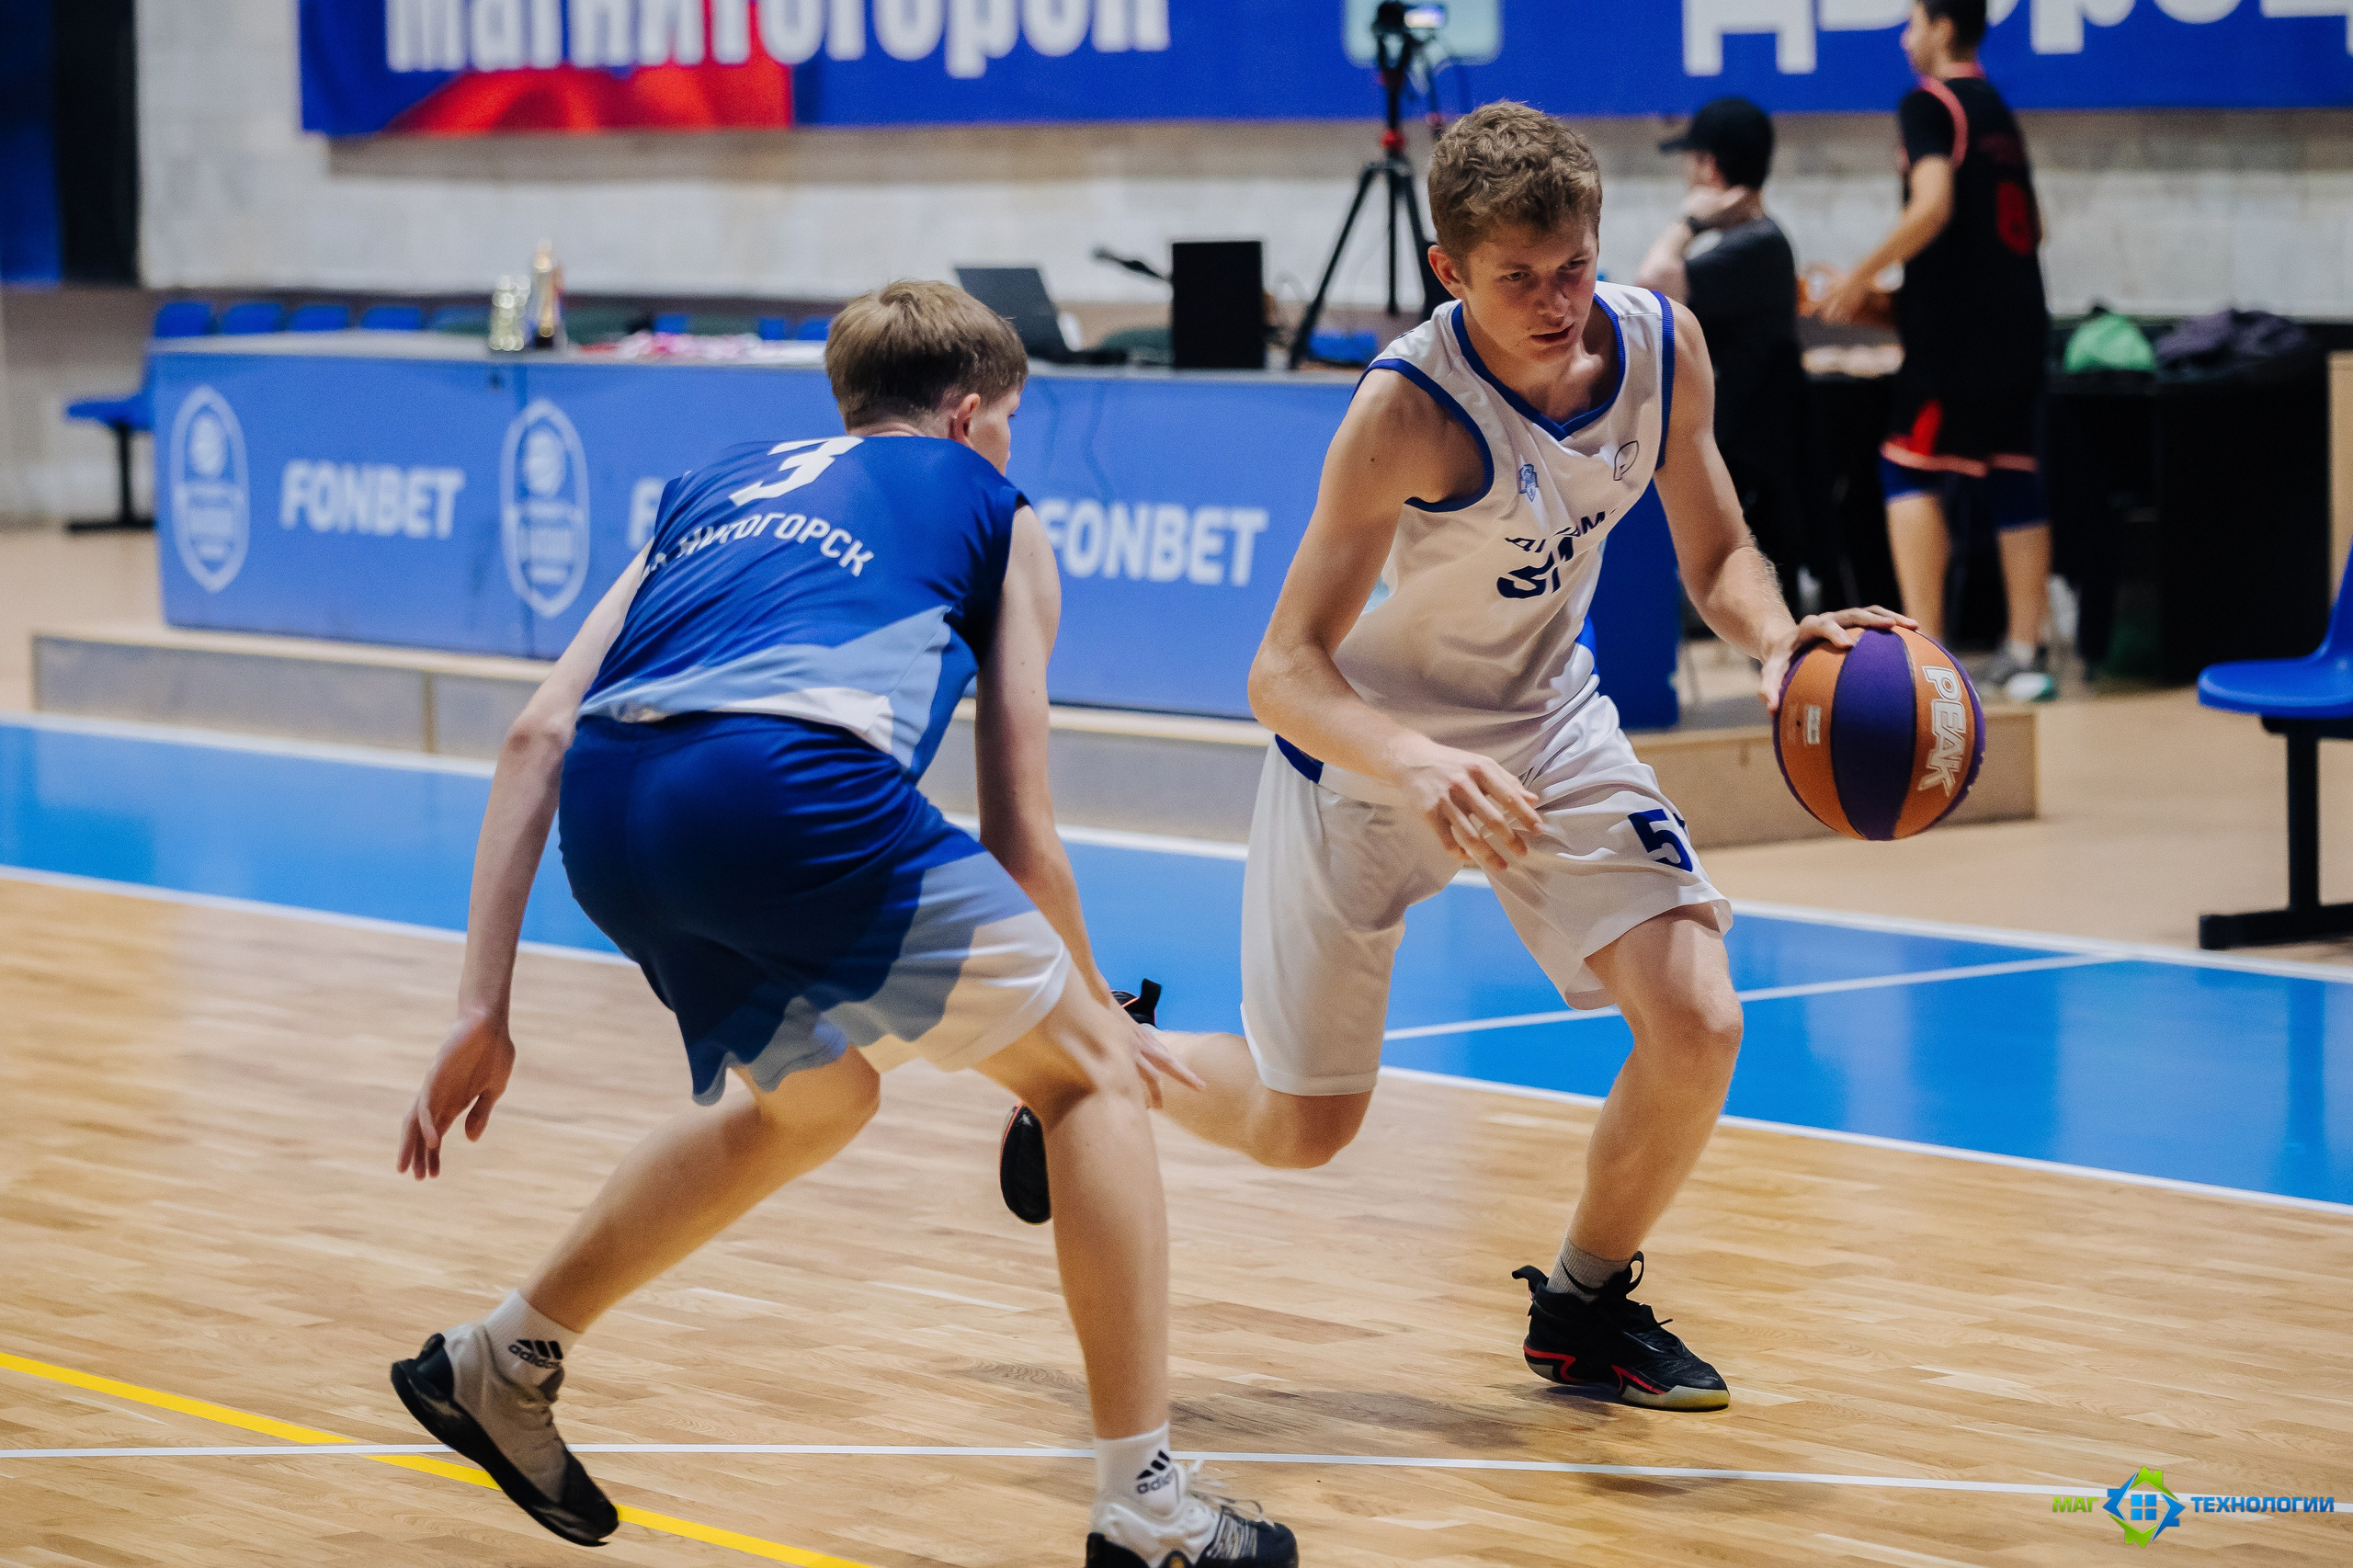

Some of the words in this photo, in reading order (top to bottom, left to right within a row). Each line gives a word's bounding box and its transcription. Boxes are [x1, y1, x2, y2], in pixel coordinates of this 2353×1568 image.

[279, 459, 466, 540] FONBET
[729, 436, 864, 507] 3
[1919, 665, 1967, 799] PEAK
